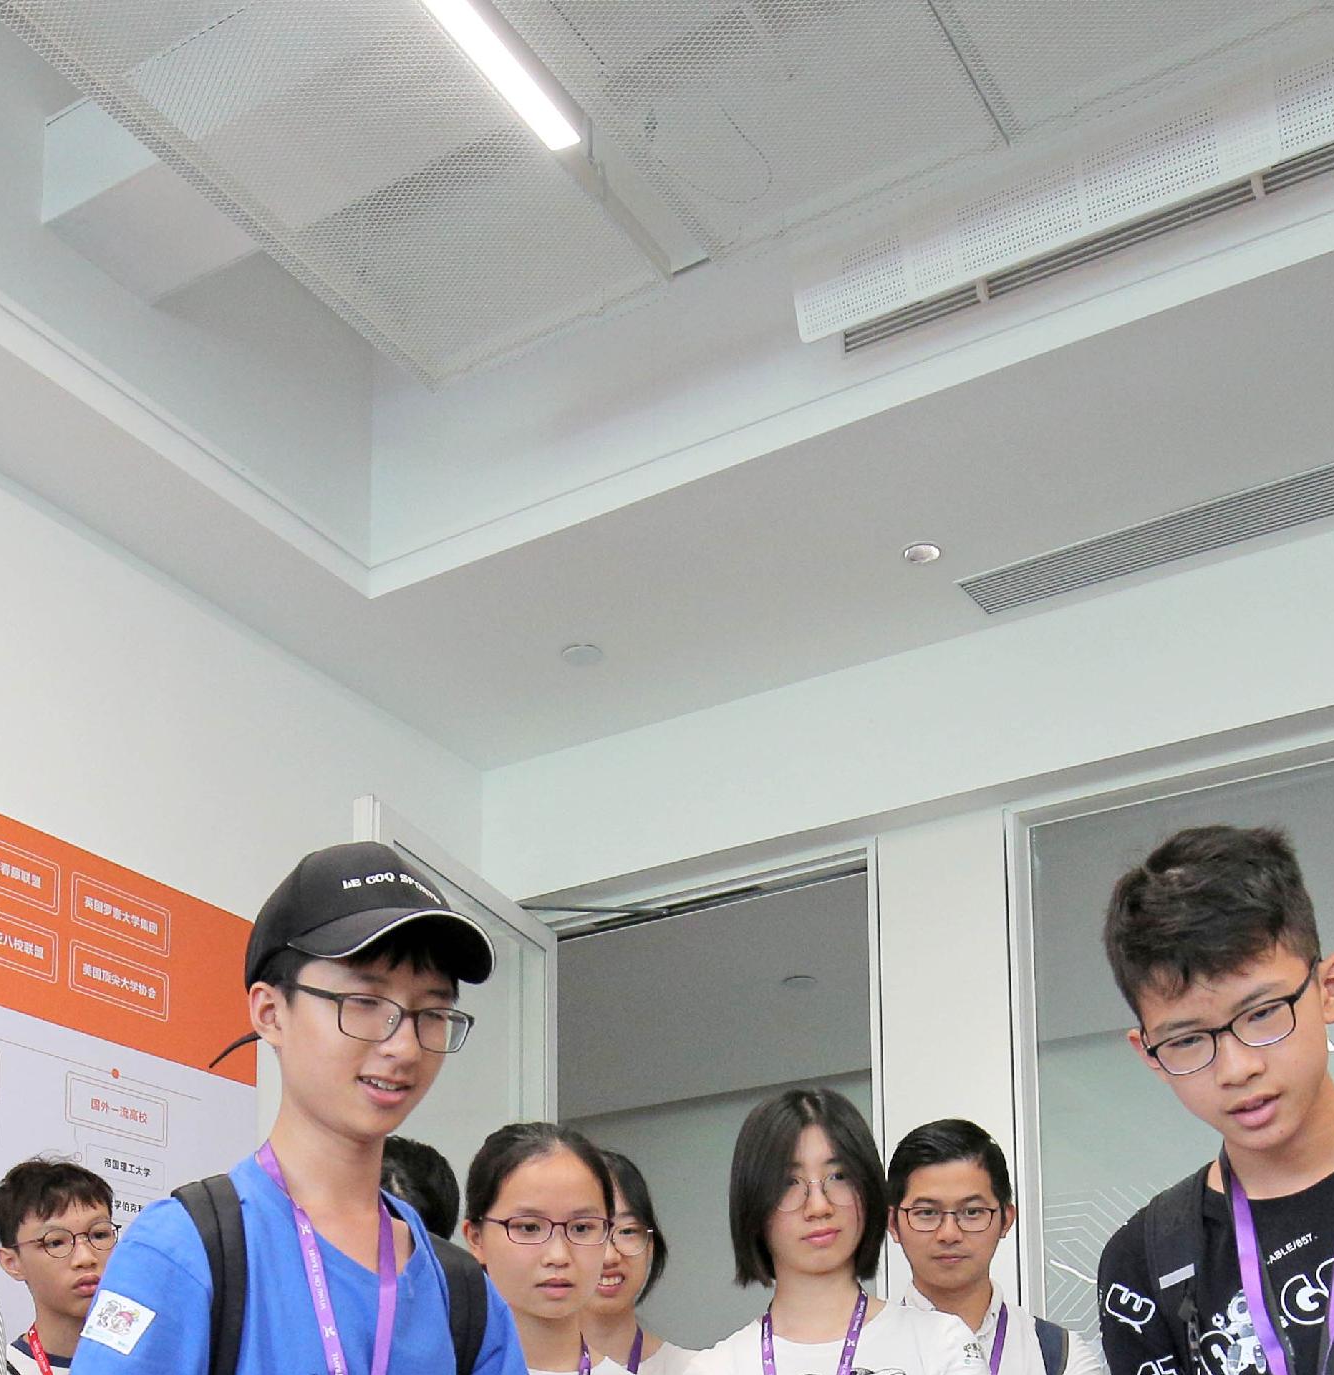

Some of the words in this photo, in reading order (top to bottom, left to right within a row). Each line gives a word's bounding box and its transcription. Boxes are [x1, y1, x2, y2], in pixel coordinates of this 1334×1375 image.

[342, 878, 362, 890] LE
[365, 871, 396, 885] COQ
[90, 1097, 148, 1125] 国外一流高校
